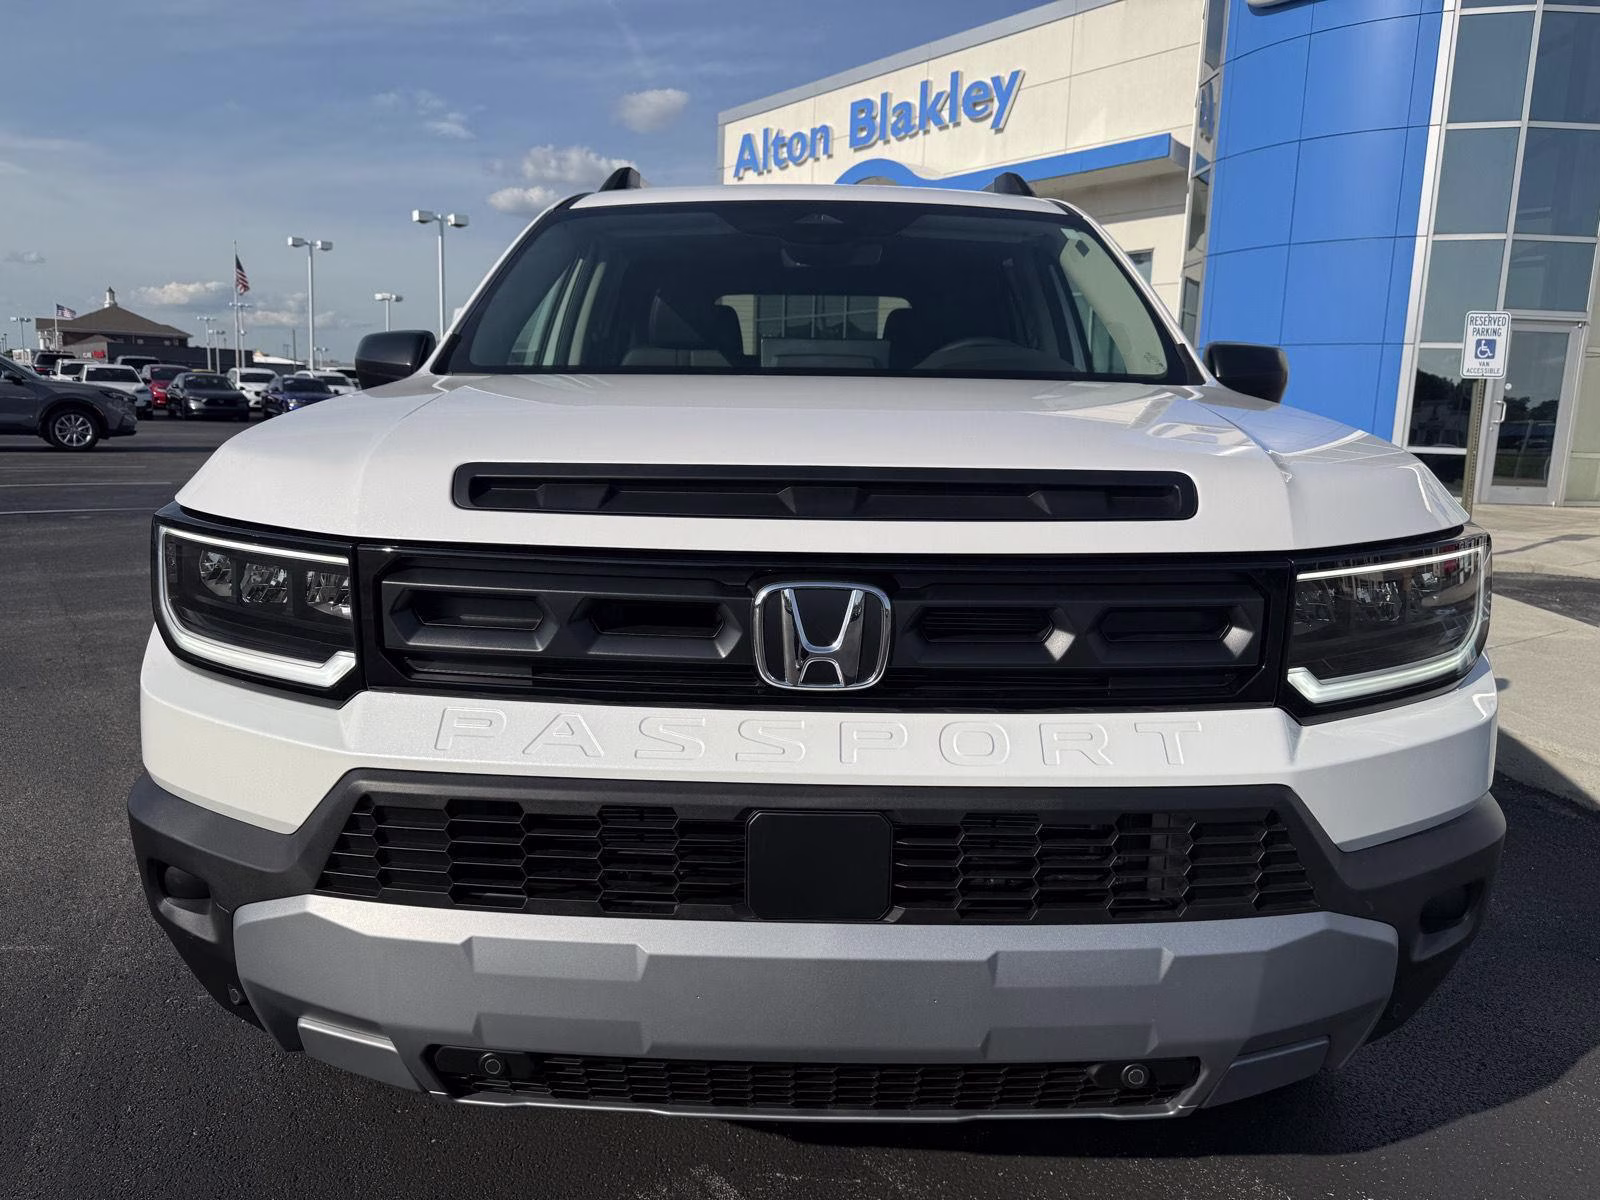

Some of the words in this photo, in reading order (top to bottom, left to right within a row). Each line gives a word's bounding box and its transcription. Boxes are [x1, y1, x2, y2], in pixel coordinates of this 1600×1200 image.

[733, 124, 832, 179] Alton
[849, 69, 1024, 152] Blakley
[1470, 316, 1507, 326] RESERVED
[1472, 328, 1502, 336] PARKING
[434, 707, 1203, 767] PASSPORT
